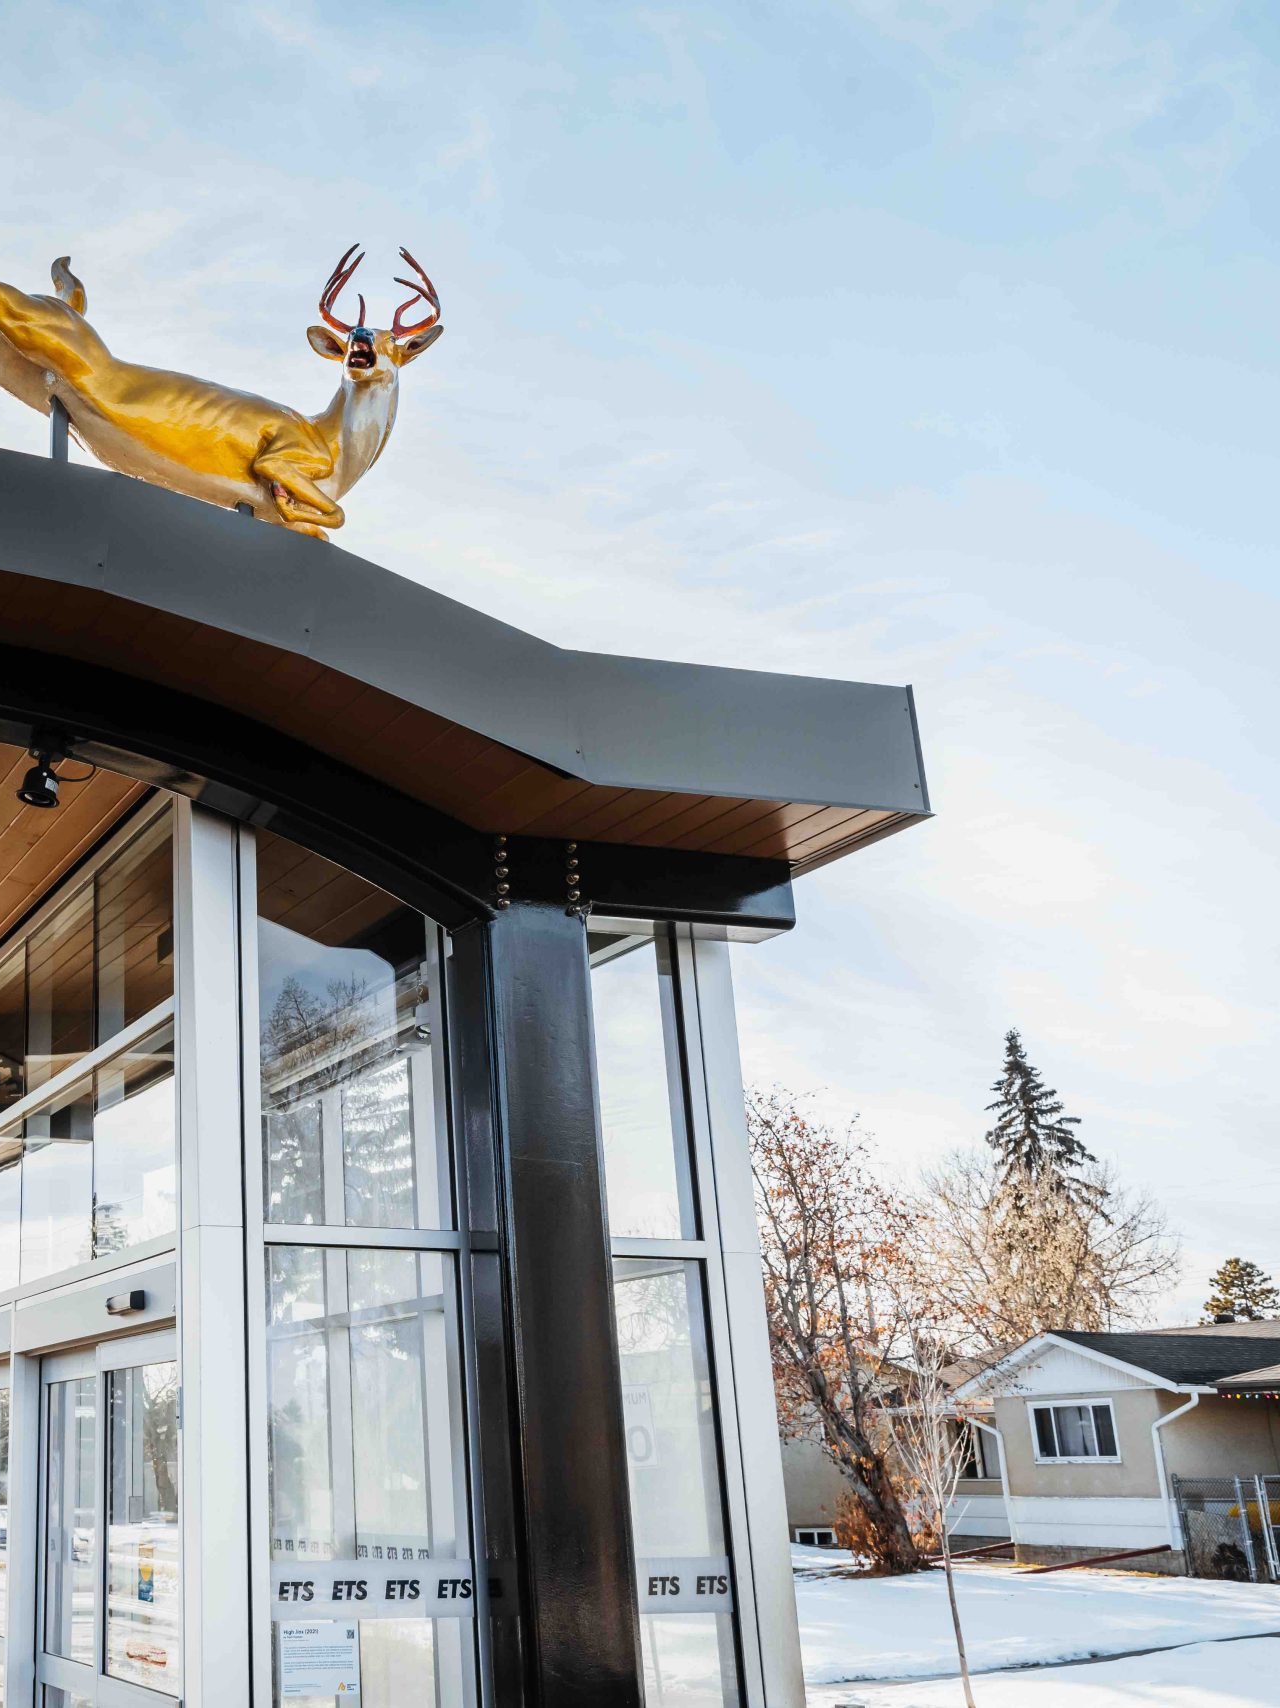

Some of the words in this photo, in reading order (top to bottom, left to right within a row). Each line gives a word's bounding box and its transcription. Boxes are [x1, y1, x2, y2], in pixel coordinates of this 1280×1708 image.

[624, 1392, 647, 1405] MUM
[278, 1580, 315, 1601] ETS
[332, 1580, 368, 1601] ETS
[385, 1579, 420, 1600] ETS
[437, 1578, 472, 1599] ETS
[648, 1576, 681, 1596] ETS
[696, 1575, 728, 1595] ETS
